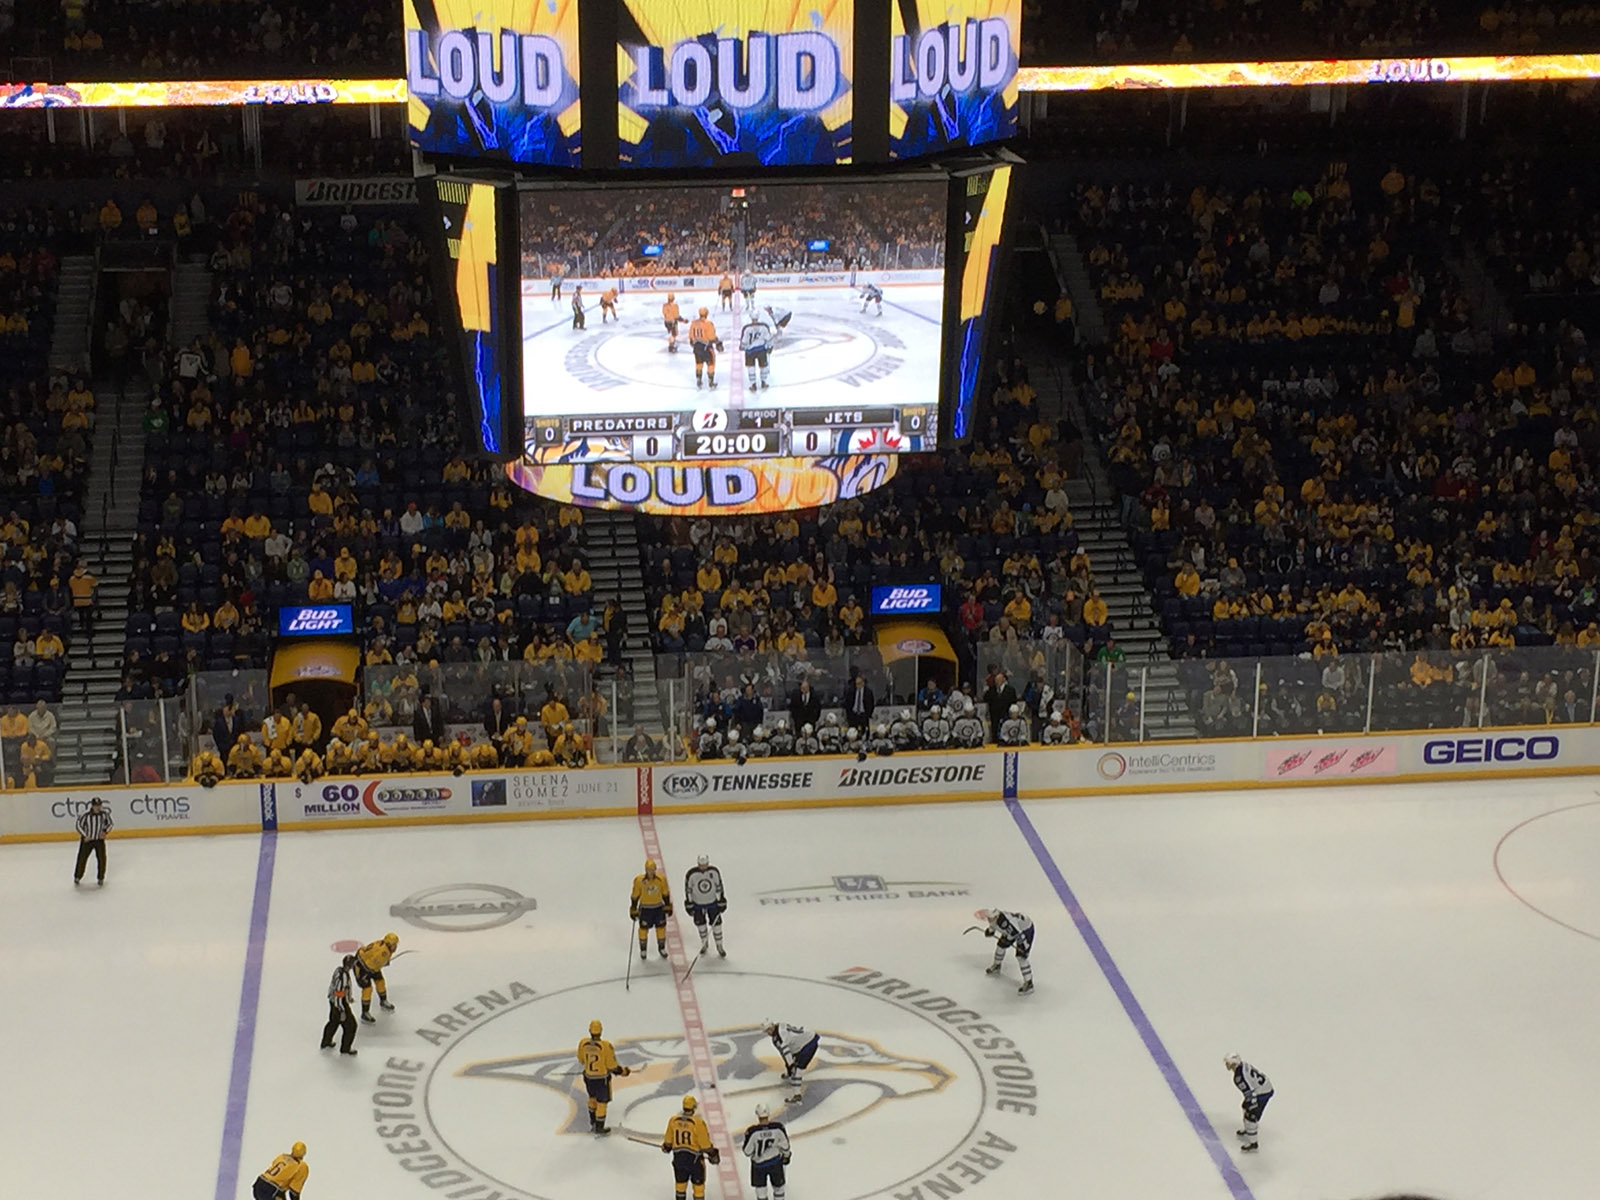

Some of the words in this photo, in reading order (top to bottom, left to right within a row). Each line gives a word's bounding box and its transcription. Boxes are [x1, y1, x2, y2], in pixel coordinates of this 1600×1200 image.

[408, 28, 563, 107] LOUD
[892, 17, 1010, 100] LOUD
[636, 31, 839, 109] LOUD
[1367, 58, 1450, 82] LOUD
[243, 82, 338, 103] LOUD
[742, 410, 777, 419] PERIOD
[754, 418, 762, 428] 1
[824, 411, 863, 424] JETS
[911, 416, 921, 430] 0
[573, 417, 667, 431] PREDATORS
[545, 428, 555, 441] 0
[805, 431, 818, 451] 0
[646, 436, 659, 457] 0
[696, 434, 767, 455] 20:00
[571, 464, 758, 507] LOUD
[888, 588, 929, 600] BUD
[879, 598, 933, 610] LIGHT
[298, 609, 338, 621] BUD
[287, 619, 344, 631] LIGHT
[1424, 736, 1560, 765] GEICO
[1128, 754, 1216, 768] IntelliCentrics
[513, 774, 569, 787] SELENA
[672, 776, 699, 789] FOX
[712, 772, 813, 792] TENNESSEE
[838, 764, 986, 788] BRIDGESTONE
[322, 784, 359, 803] 60
[513, 786, 569, 799] GOMEZ
[576, 784, 602, 794] JUNE
[606, 782, 618, 792] 21
[130, 794, 190, 815] ctms
[304, 803, 360, 813] MILLION
[759, 896, 821, 906] FIFTH
[828, 893, 900, 902] THIRD
[907, 888, 972, 899] BANK
[403, 901, 523, 917] NISSAN
[415, 982, 536, 1047] ARENA
[826, 966, 1037, 1117] BRIDGESTONE
[585, 1053, 599, 1072] 12
[675, 1129, 691, 1146] 18
[757, 1138, 775, 1157] 16
